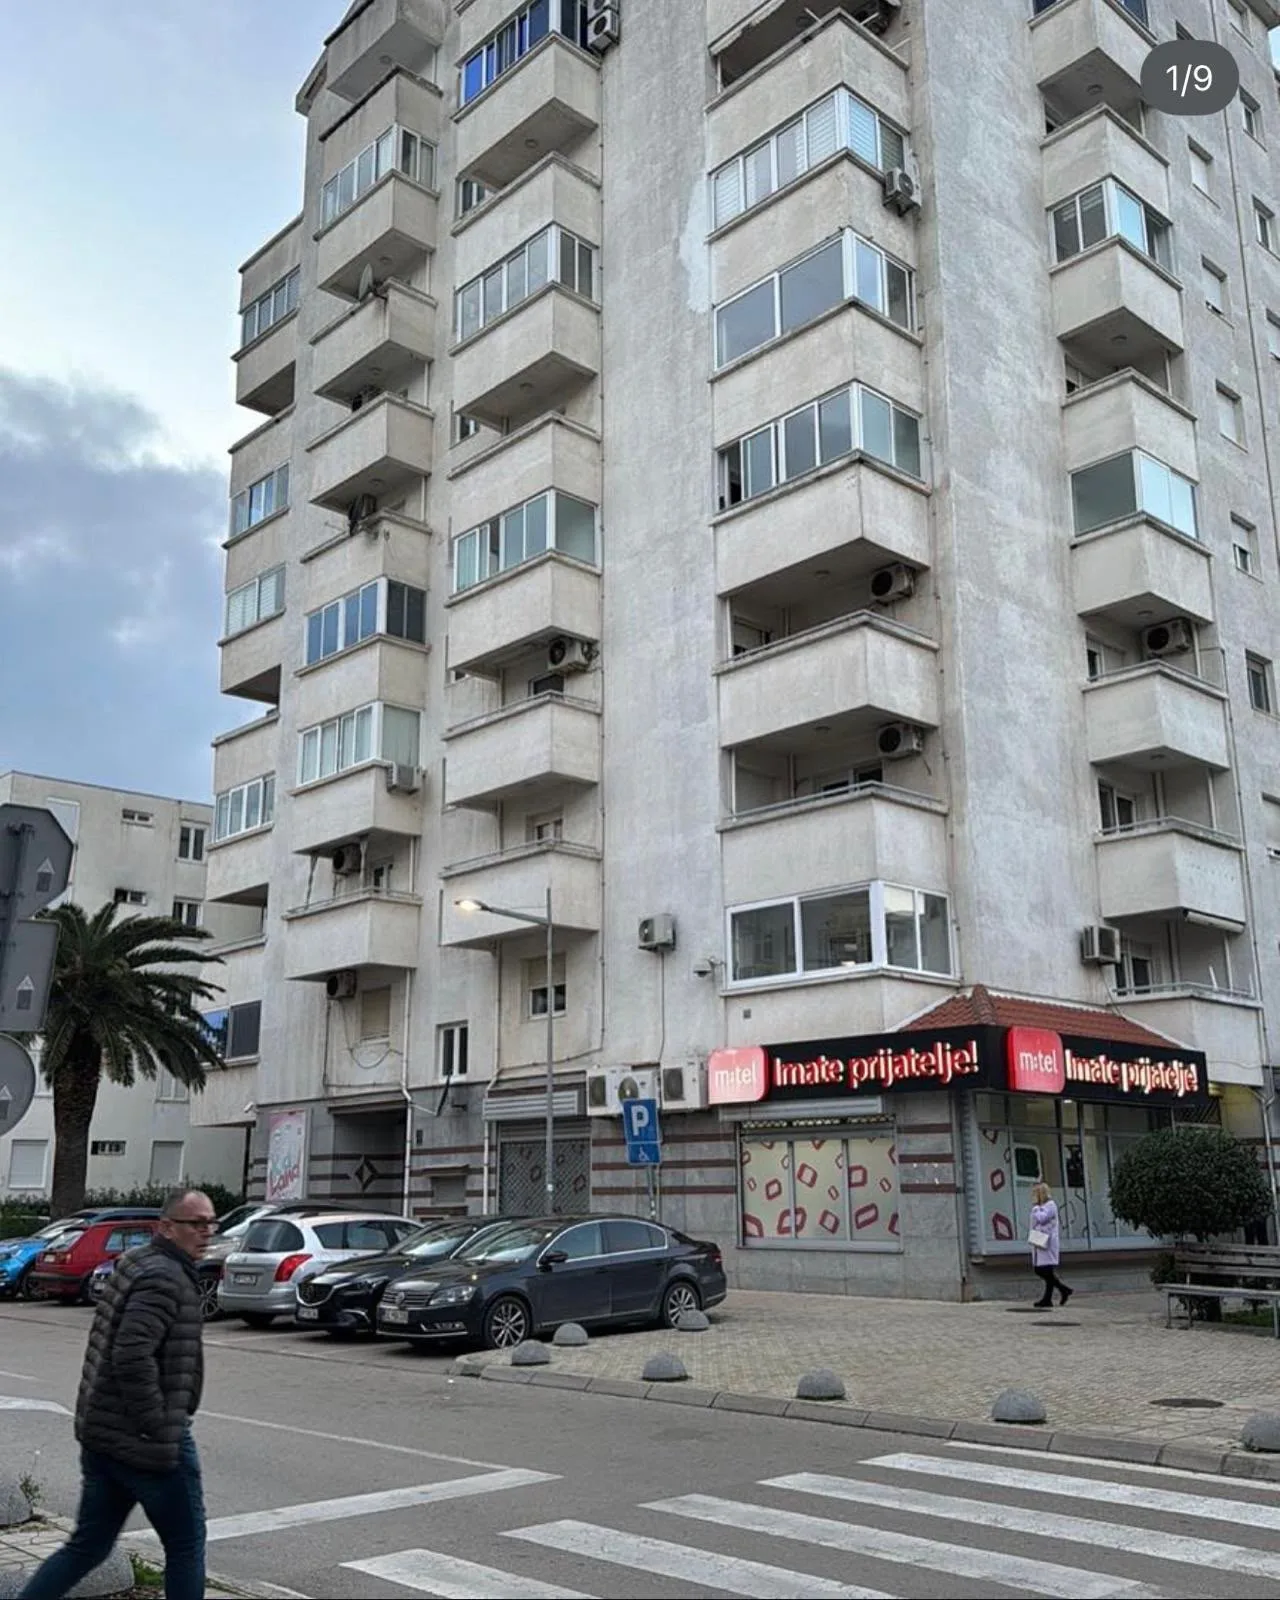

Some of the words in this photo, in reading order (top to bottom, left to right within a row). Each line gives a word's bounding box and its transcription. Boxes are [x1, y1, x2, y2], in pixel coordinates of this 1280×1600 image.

[774, 1055, 844, 1087] Imate
[850, 1039, 980, 1089] prijatelje!
[1064, 1048, 1120, 1085] Imate
[630, 1104, 650, 1137] P
